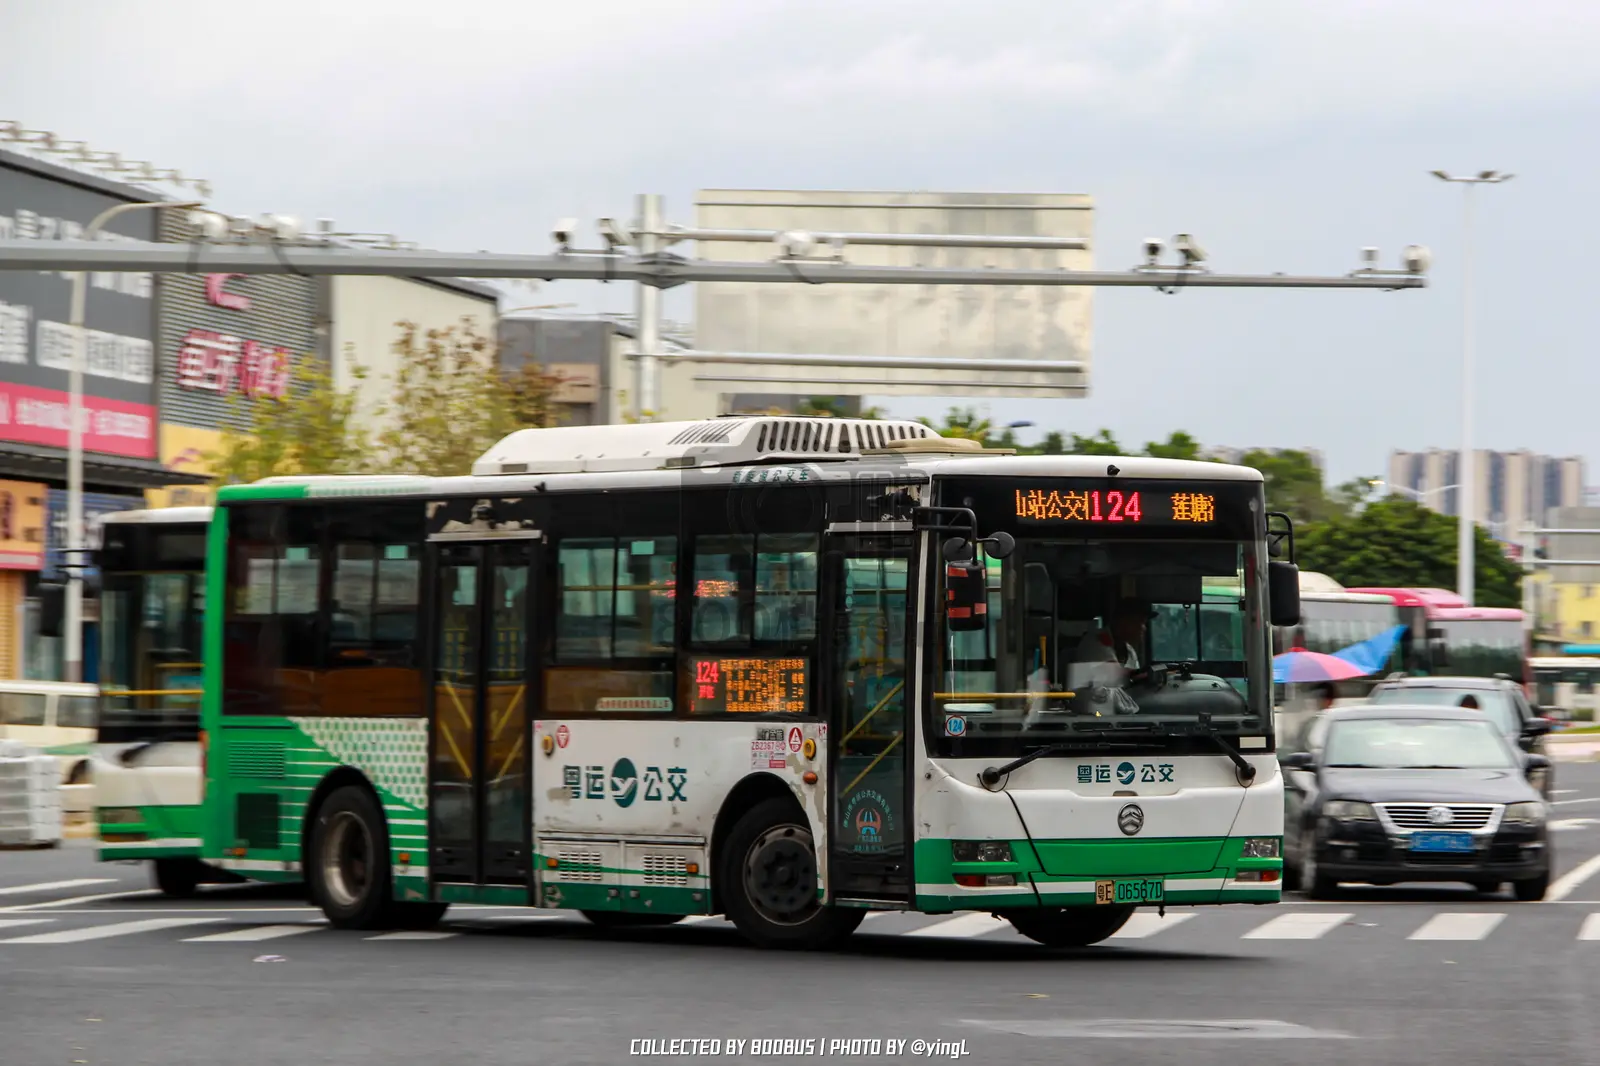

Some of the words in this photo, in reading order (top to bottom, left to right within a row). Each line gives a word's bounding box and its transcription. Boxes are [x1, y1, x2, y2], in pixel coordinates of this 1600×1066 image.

[1091, 491, 1141, 521] 124
[696, 661, 719, 683] 124
[948, 719, 963, 733] 124
[643, 766, 688, 802] 公交
[1077, 764, 1111, 783] 粤运
[1141, 764, 1174, 783] 公交
